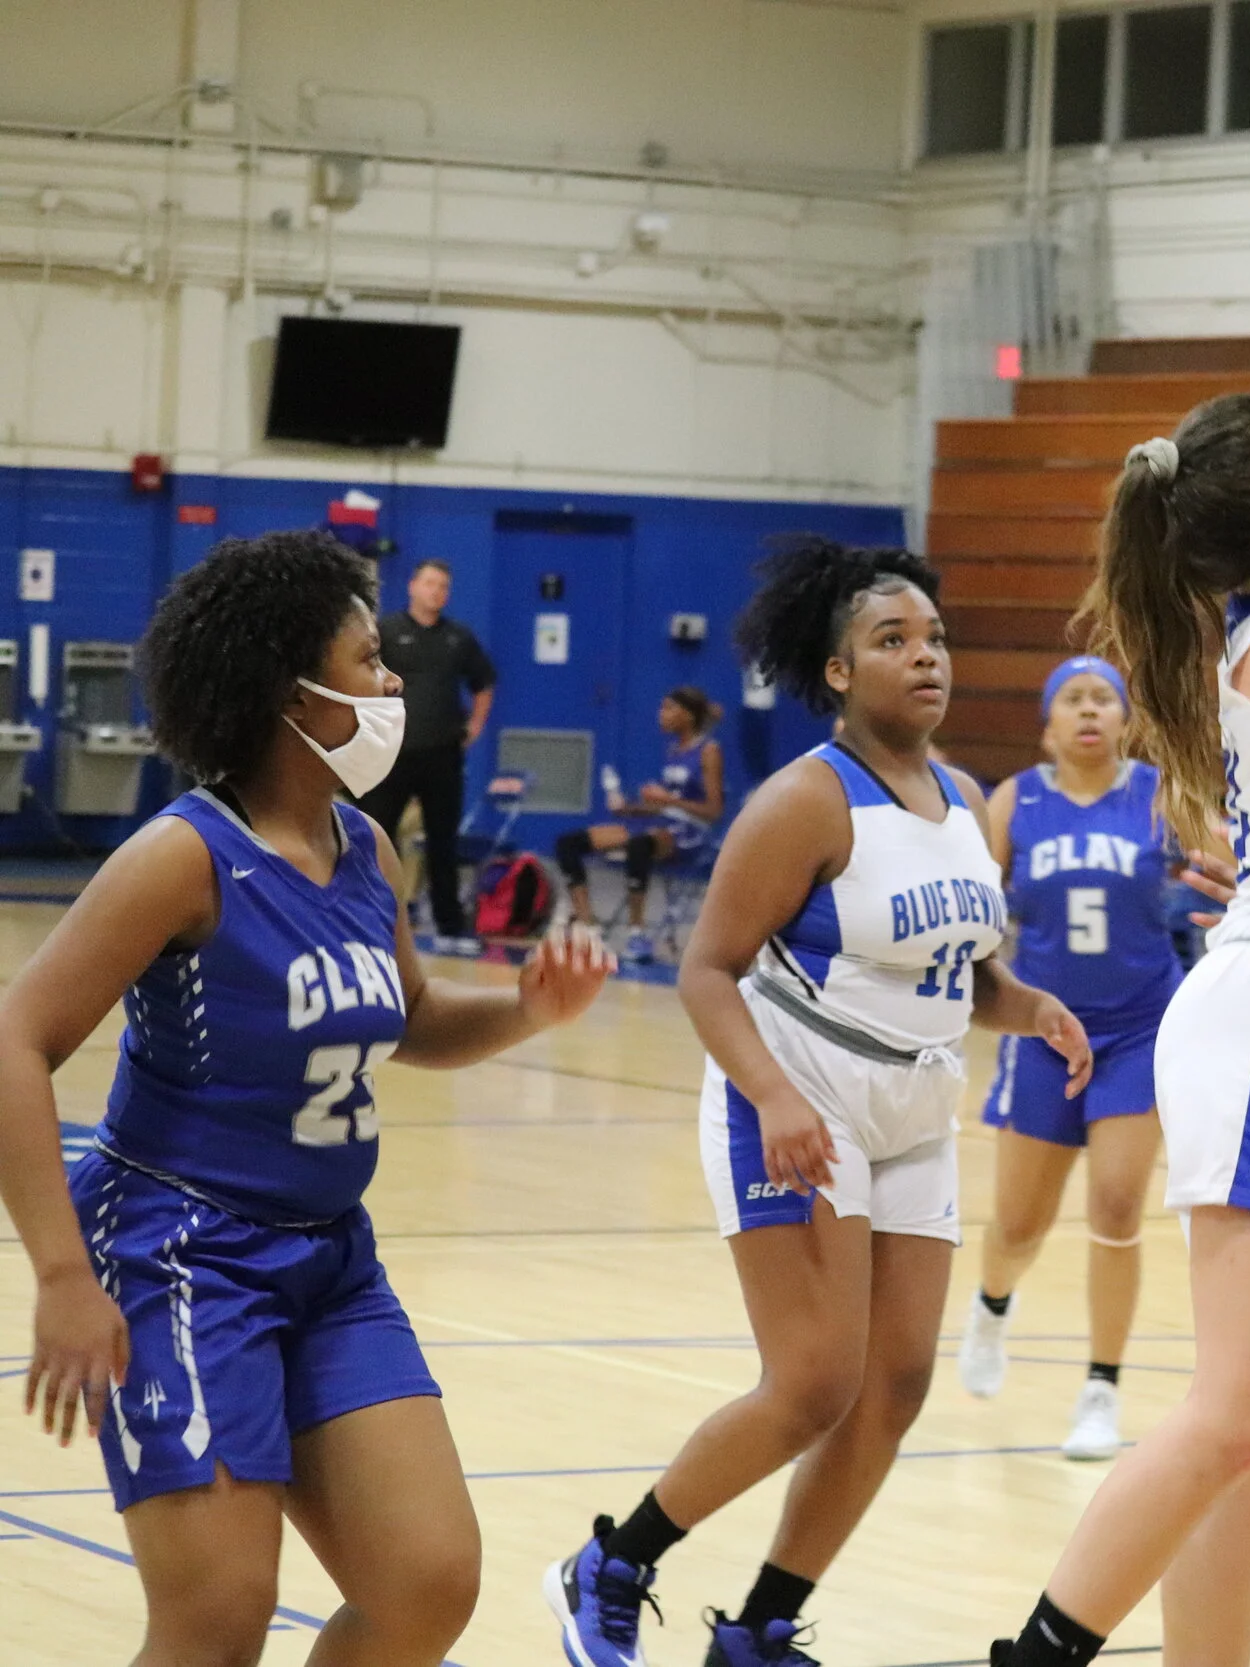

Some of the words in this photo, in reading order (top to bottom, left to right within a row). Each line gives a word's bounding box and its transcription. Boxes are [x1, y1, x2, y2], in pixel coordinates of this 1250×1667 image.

[1030, 832, 1140, 881] CLAY
[890, 880, 952, 943] BLUE
[950, 878, 1008, 934] DEVIL
[1067, 887, 1108, 955] 5
[915, 940, 978, 1001] 12
